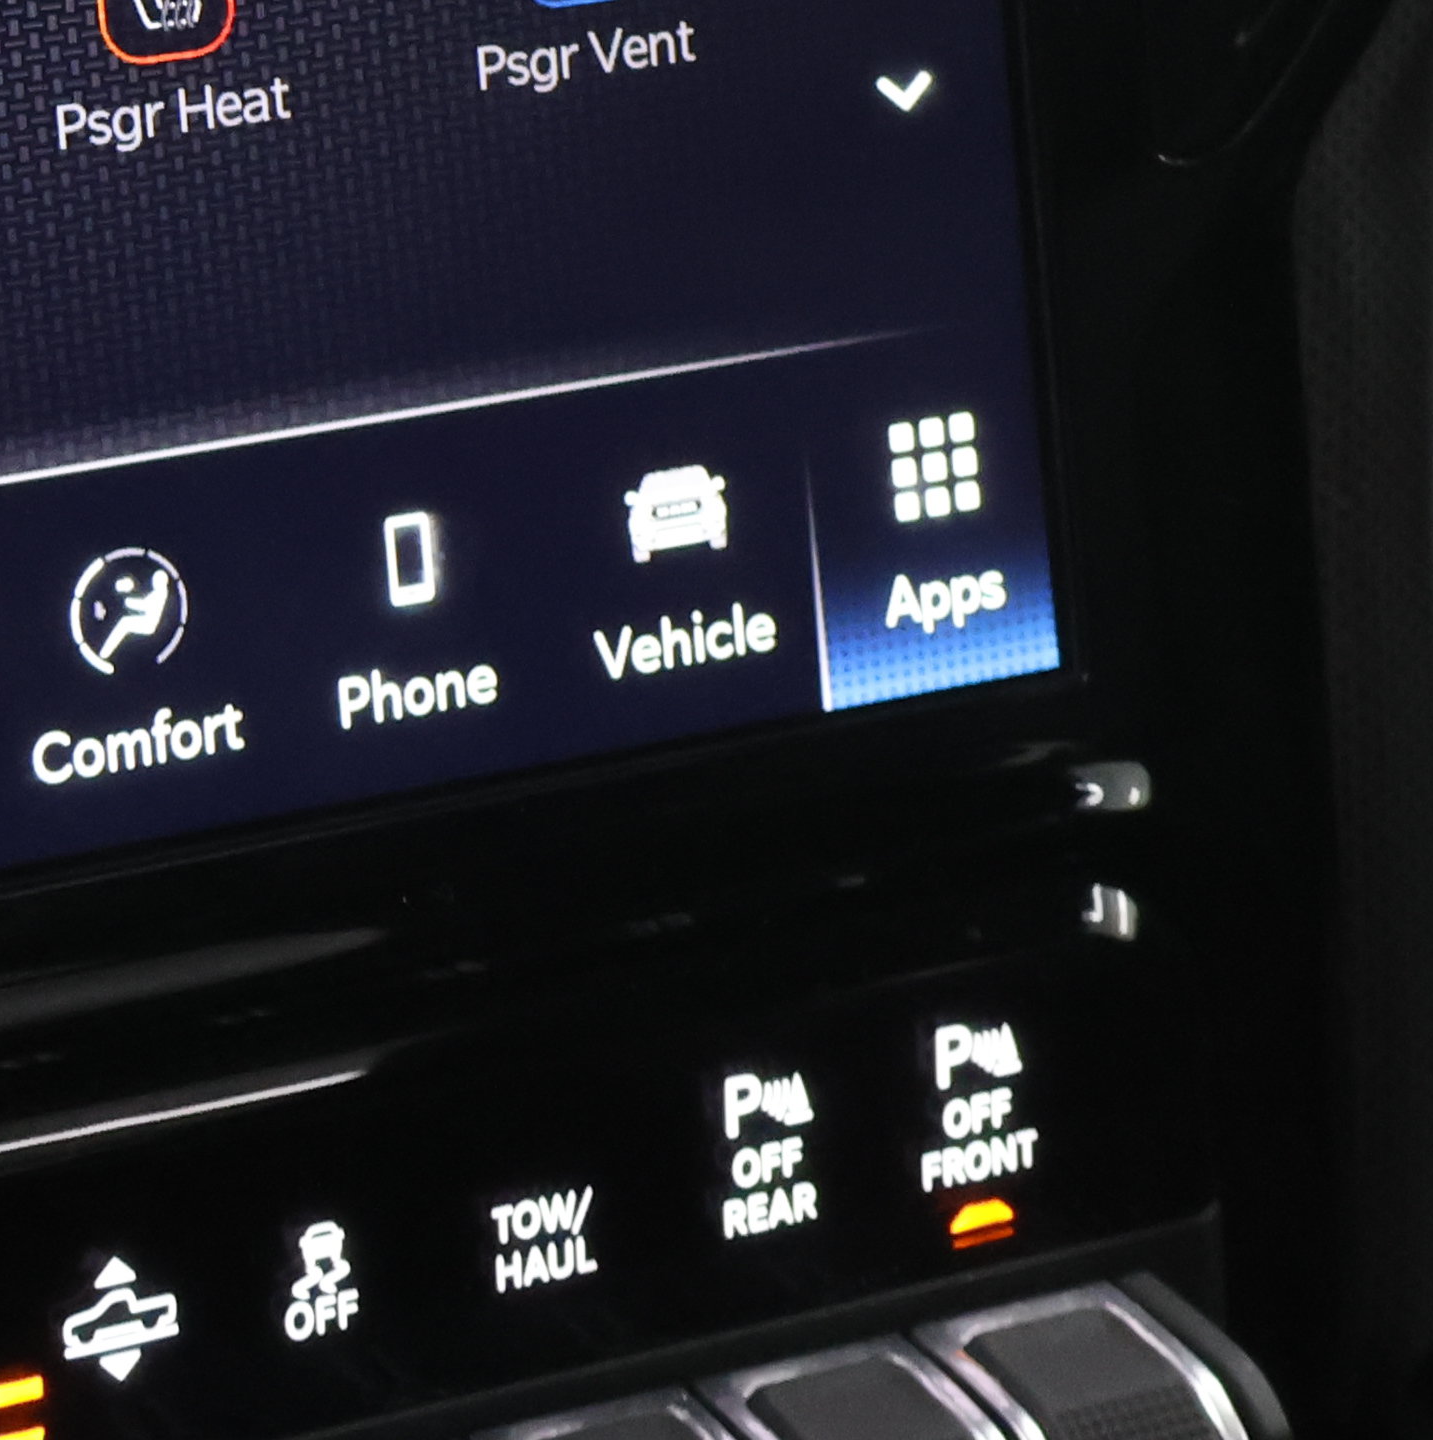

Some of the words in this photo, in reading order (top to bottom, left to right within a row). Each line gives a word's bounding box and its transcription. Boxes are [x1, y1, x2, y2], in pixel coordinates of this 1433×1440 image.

[477, 37, 581, 92] Psgr
[590, 19, 696, 76] Vent
[56, 97, 166, 151] Psgr
[178, 77, 292, 136] Heat
[885, 567, 1006, 634] Apps
[594, 603, 777, 679] Vehicle
[339, 663, 498, 728] Phone
[32, 704, 245, 784] Comfort
[942, 1087, 1012, 1140] OFF
[733, 1140, 804, 1188] OFF
[922, 1129, 1038, 1191] FRONT
[492, 1186, 594, 1237] TOW/
[724, 1180, 818, 1239] REAR
[495, 1237, 597, 1292] HAUL
[285, 1290, 359, 1341] OFF
